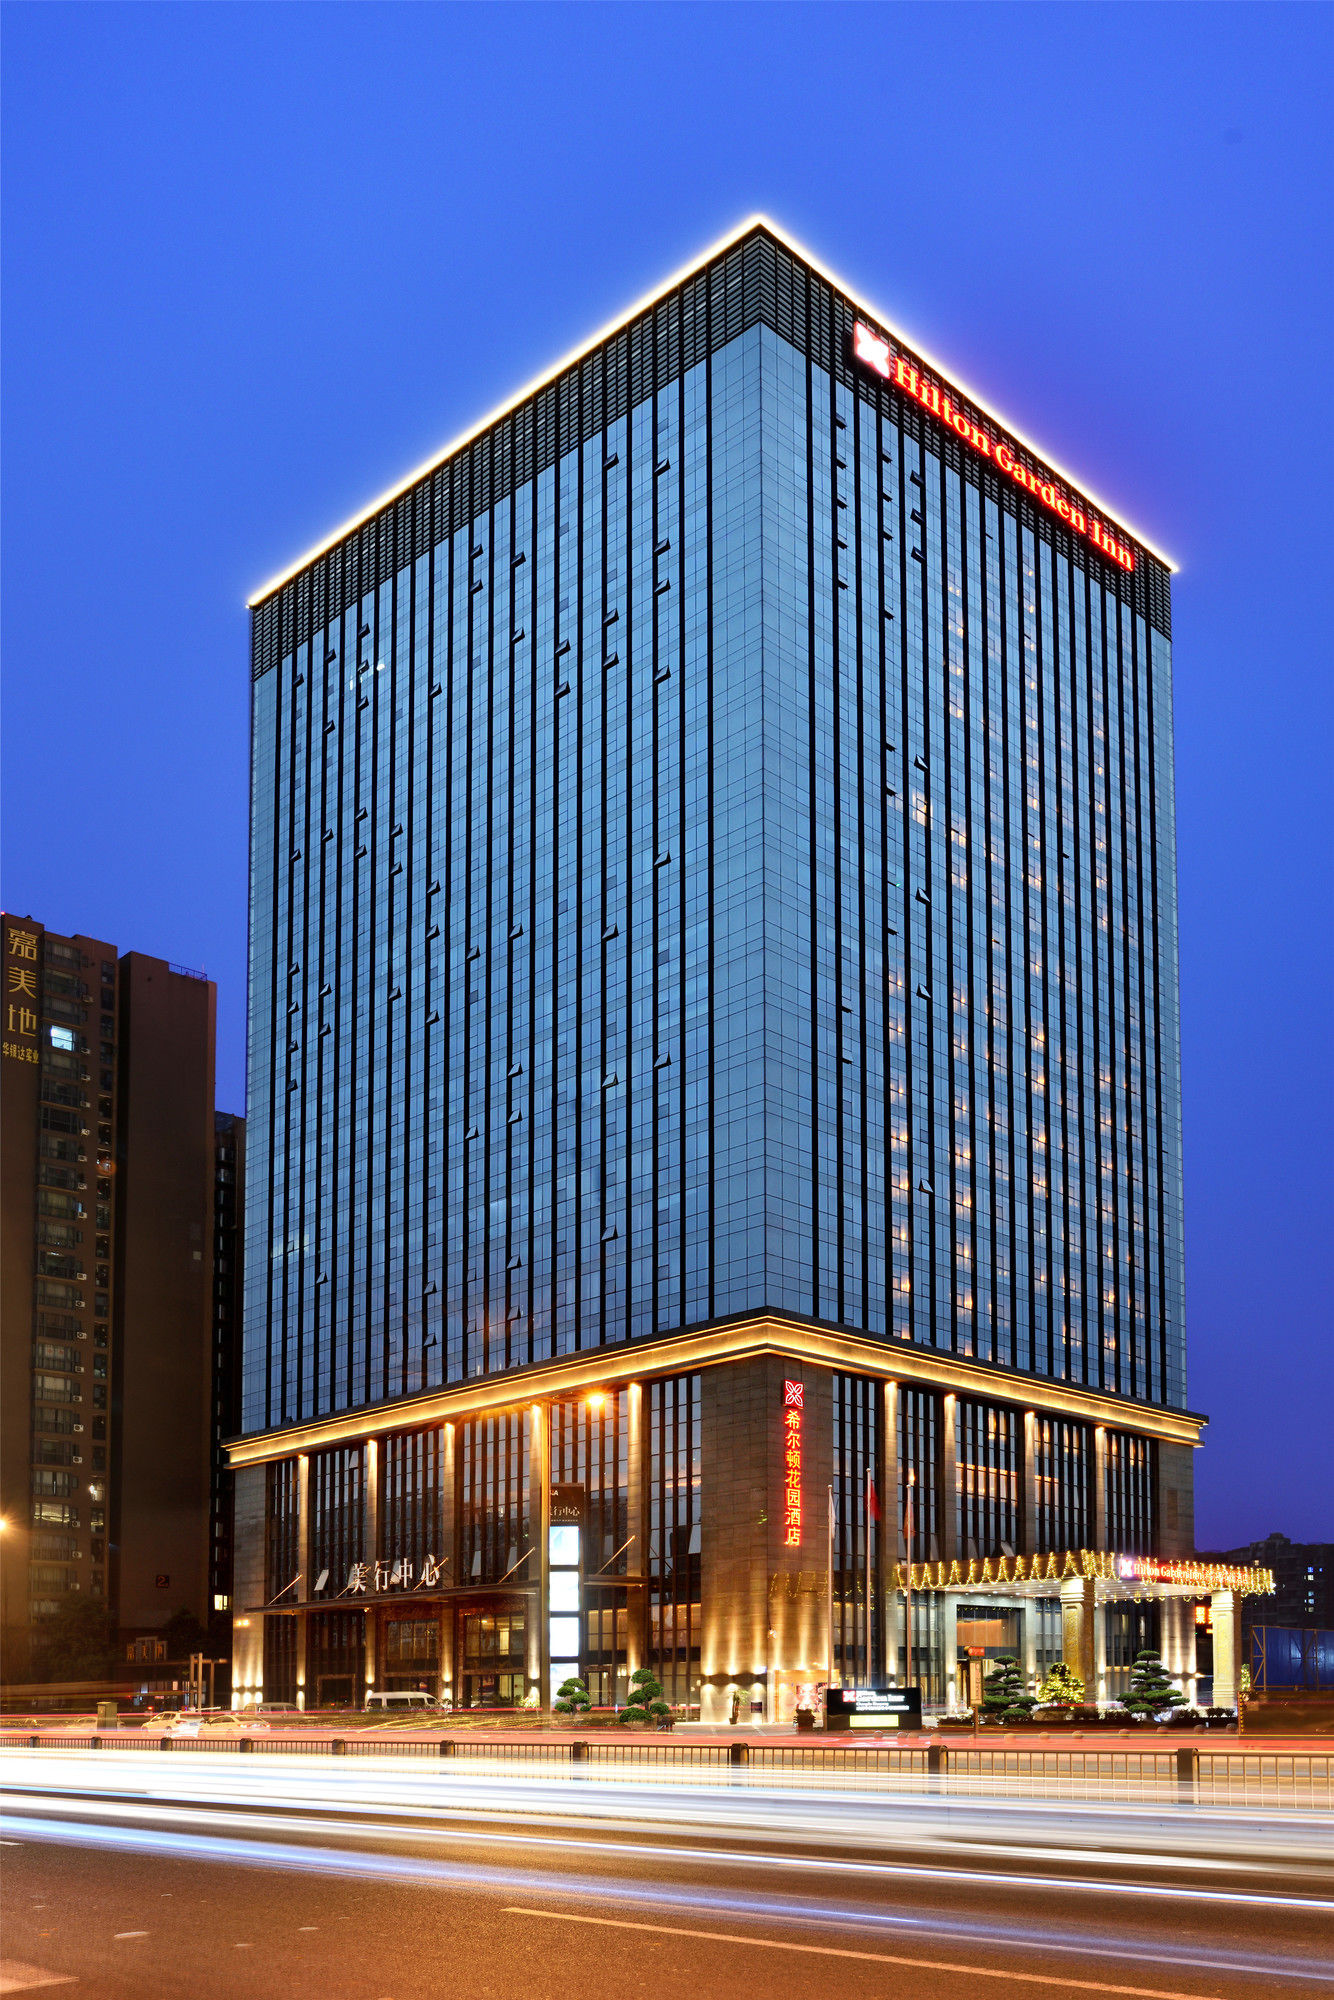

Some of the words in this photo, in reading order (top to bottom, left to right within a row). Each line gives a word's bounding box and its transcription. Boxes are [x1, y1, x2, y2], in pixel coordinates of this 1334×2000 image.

[892, 356, 991, 457] Hilton
[994, 444, 1087, 534] Garden
[1091, 519, 1134, 573] Inn
[7, 927, 38, 1037] 嘉美地
[783, 1410, 802, 1546] 希尔顿花园酒店
[351, 1553, 440, 1595] 美行中心
[1134, 1563, 1160, 1577] Hilton
